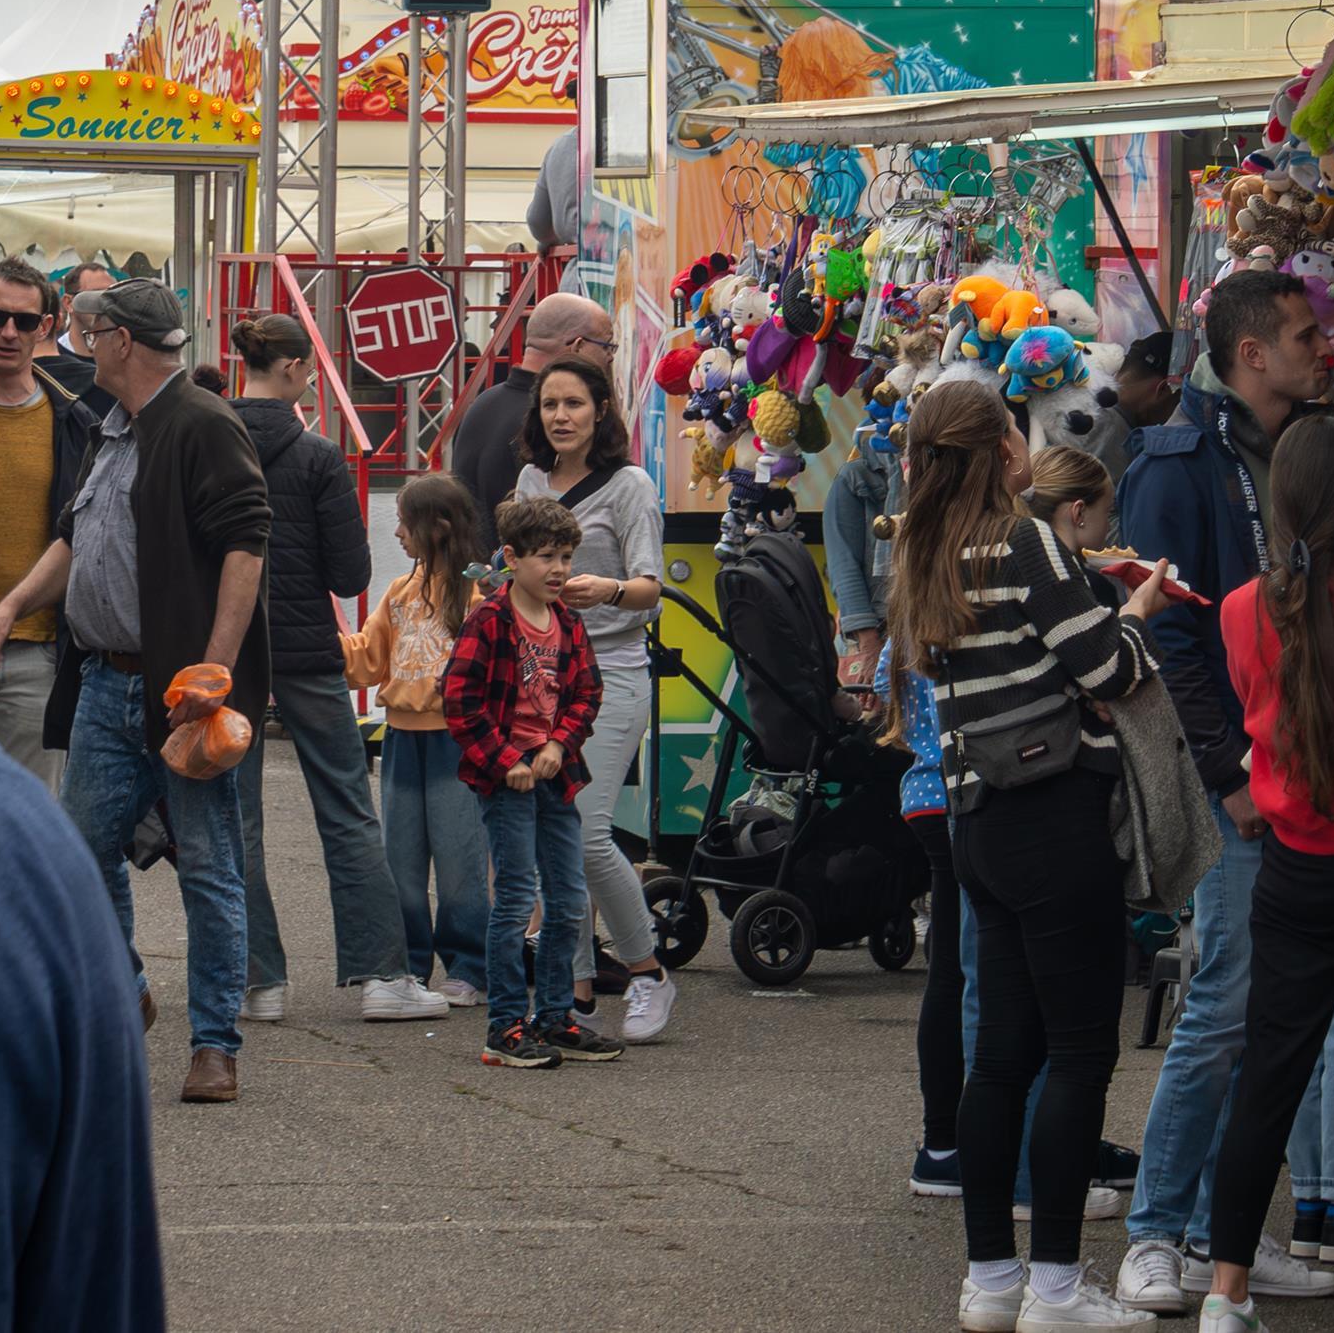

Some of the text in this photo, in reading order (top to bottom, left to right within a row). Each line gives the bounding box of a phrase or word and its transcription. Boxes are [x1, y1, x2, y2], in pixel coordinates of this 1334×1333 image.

[467, 11, 579, 100] Crêp
[19, 96, 186, 141] Sonnier
[350, 294, 452, 354] STOP
